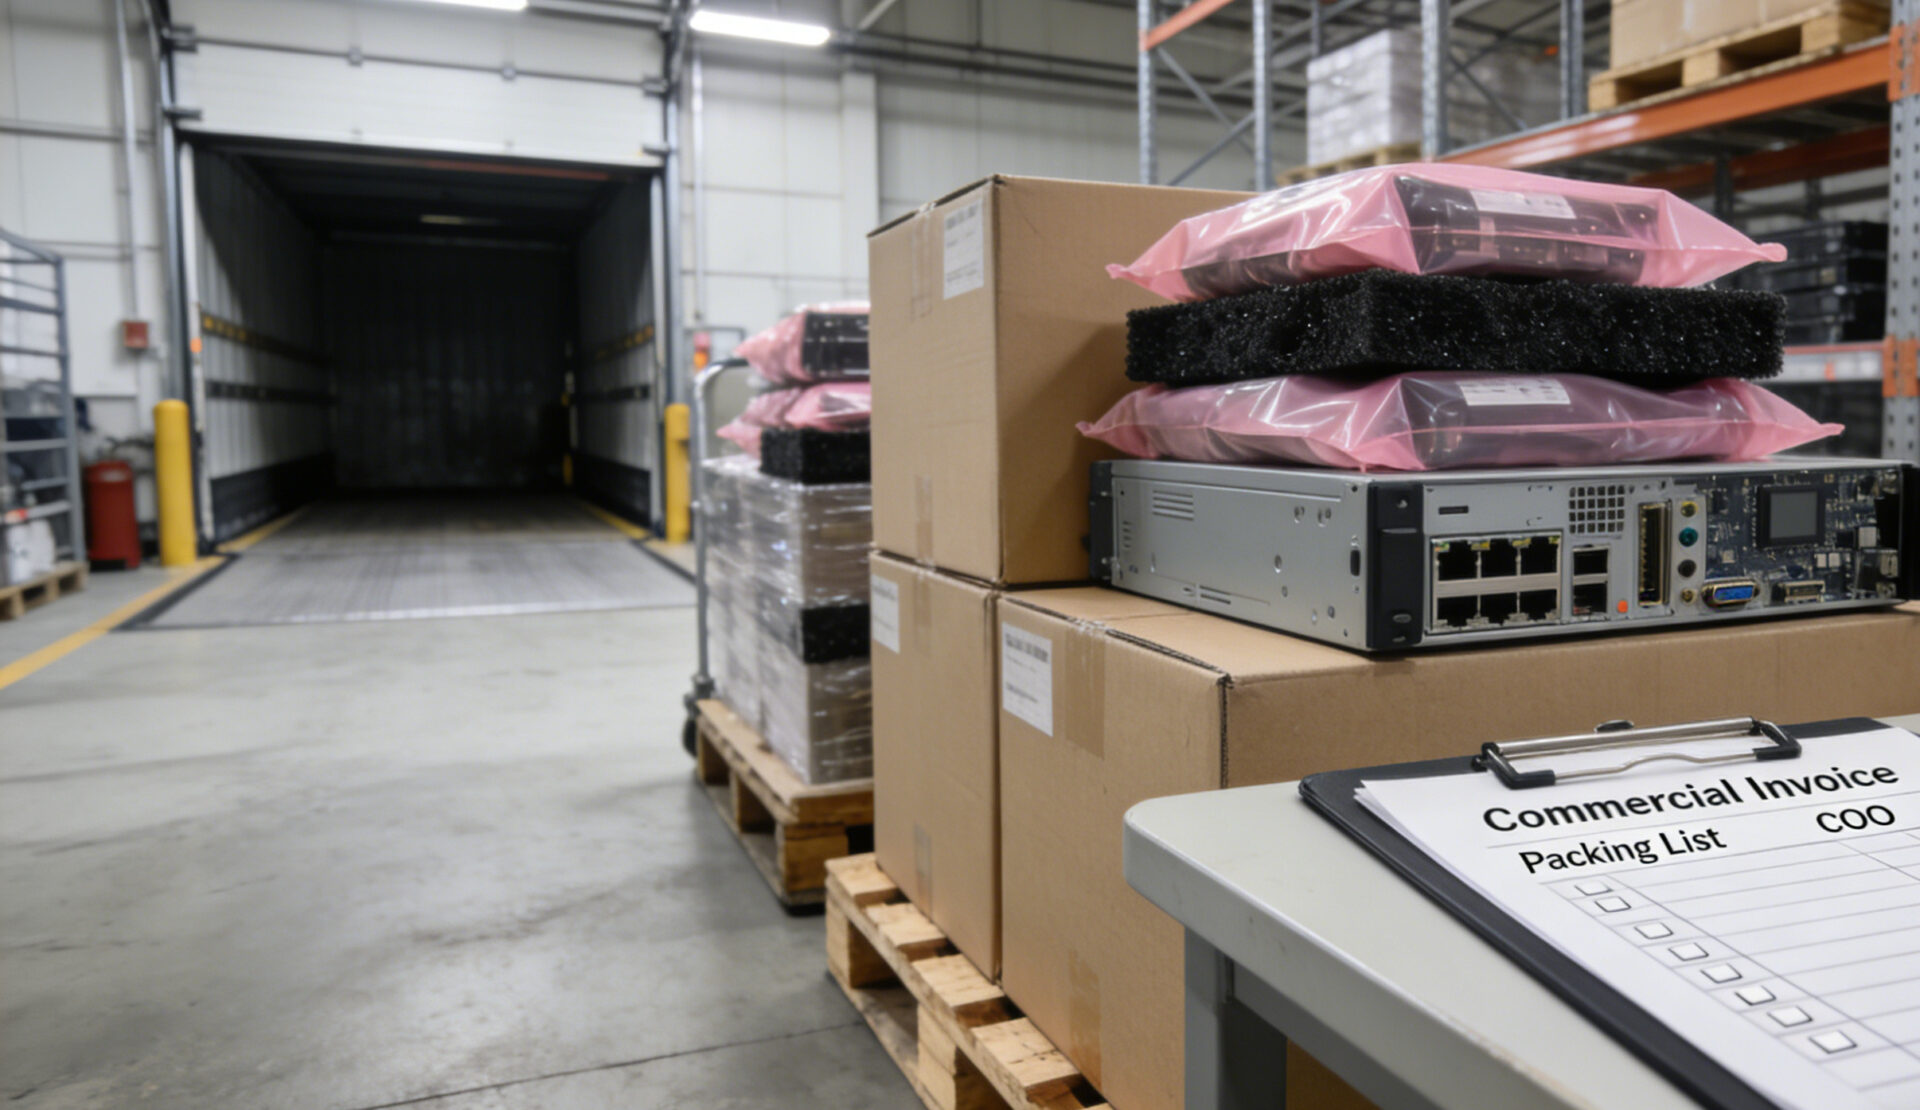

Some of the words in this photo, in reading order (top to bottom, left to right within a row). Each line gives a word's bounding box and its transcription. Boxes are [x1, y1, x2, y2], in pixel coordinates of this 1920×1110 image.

[1483, 778, 1745, 832] Commercial
[1744, 766, 1900, 801] Invoice
[1815, 804, 1896, 834] COO
[1518, 838, 1660, 874] Packing
[1659, 827, 1728, 855] List
